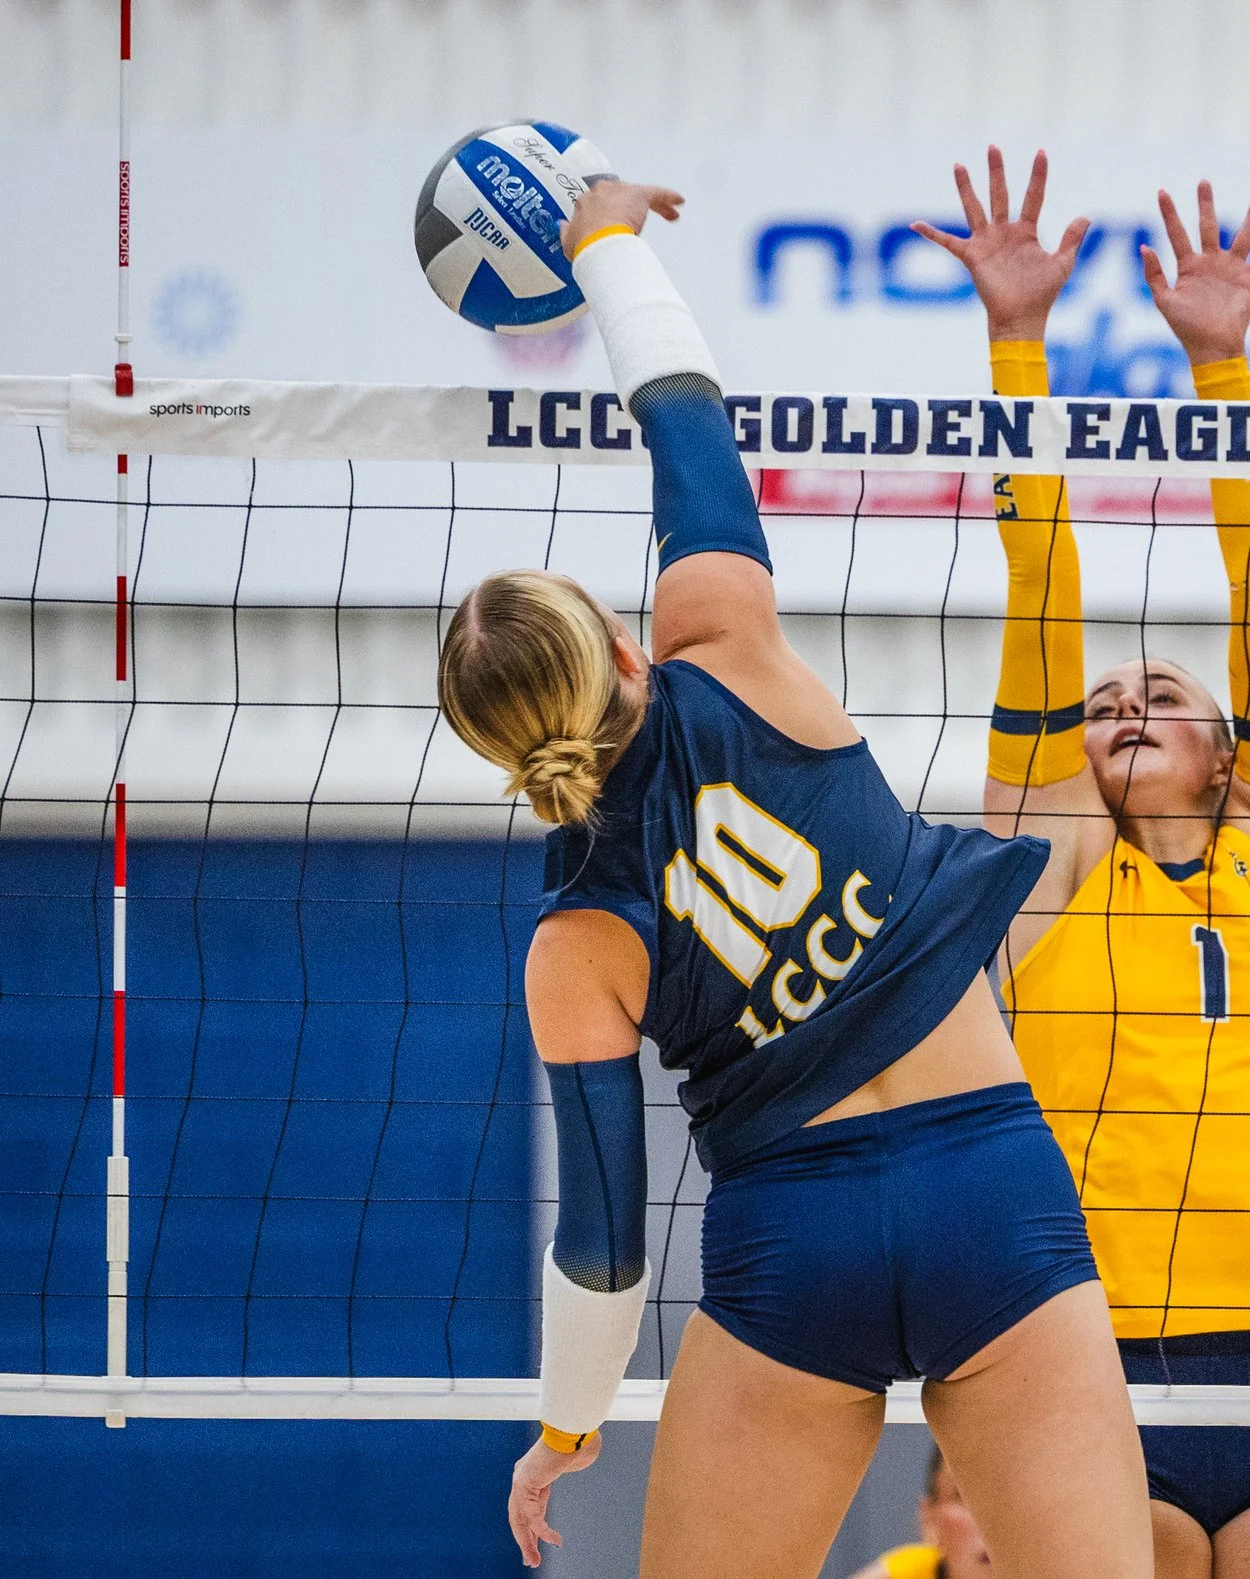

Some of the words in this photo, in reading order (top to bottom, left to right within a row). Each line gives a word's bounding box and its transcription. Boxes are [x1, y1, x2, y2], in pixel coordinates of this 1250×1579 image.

[513, 138, 555, 171] Super
[120, 162, 129, 207] sports
[120, 208, 129, 264] imports
[463, 206, 510, 250] NJCAA
[149, 402, 194, 417] sports
[196, 404, 251, 418] imports
[487, 390, 651, 450] LCC
[724, 395, 1033, 459] GOLDEN
[664, 782, 822, 989] 10
[1191, 923, 1230, 1023] 1
